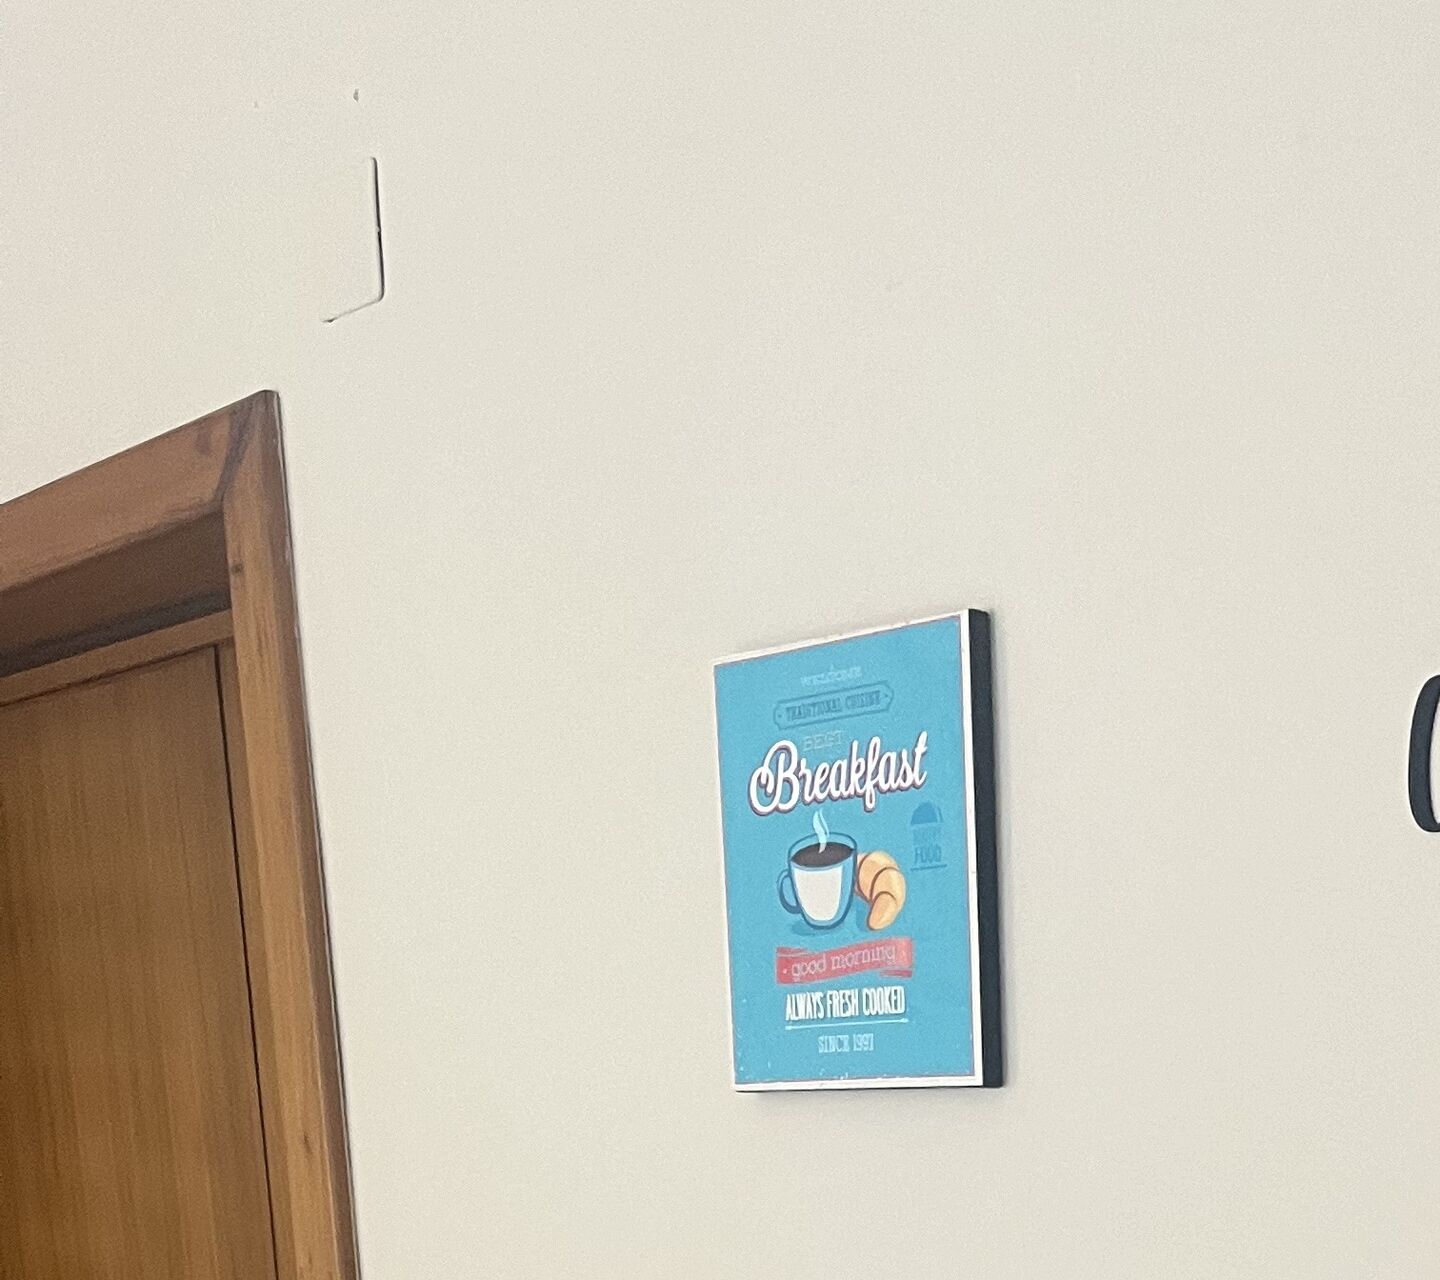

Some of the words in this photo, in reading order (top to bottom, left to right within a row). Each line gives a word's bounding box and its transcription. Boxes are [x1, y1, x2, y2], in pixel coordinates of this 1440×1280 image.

[748, 730, 929, 815] Breakfast
[791, 953, 827, 982] good
[830, 944, 897, 970] morning
[785, 992, 825, 1022] ALWAYS
[826, 988, 859, 1018] FRESH
[862, 985, 906, 1016] COOKED
[817, 1034, 850, 1054] SINCE
